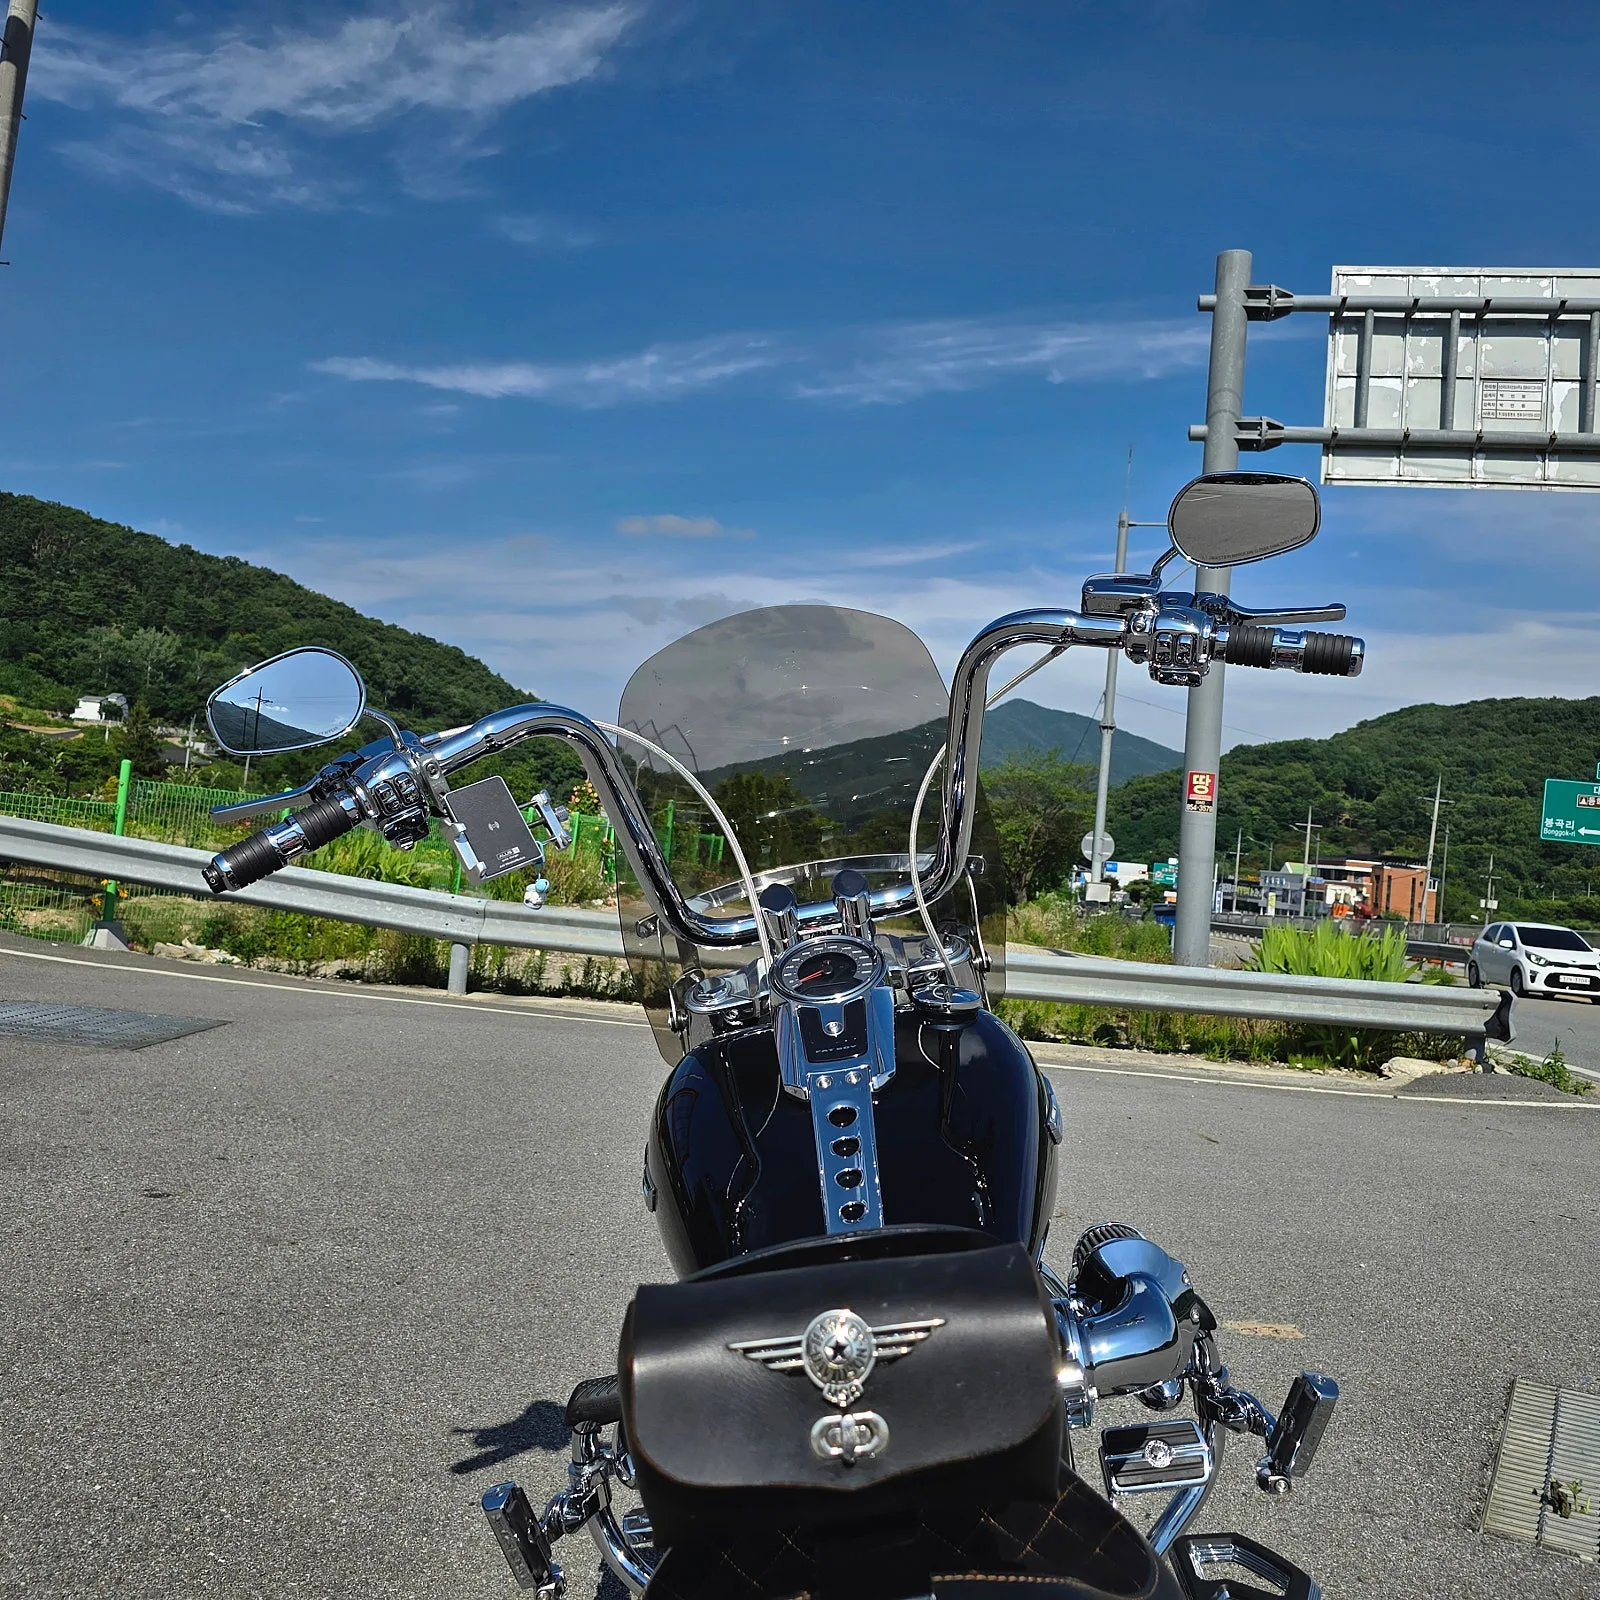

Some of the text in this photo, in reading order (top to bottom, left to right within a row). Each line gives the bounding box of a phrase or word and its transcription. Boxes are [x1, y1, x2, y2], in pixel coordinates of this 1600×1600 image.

[1192, 774, 1212, 795] 땅
[1544, 817, 1575, 830] 봉곡리
[1543, 827, 1576, 837] Bonggok-ri
